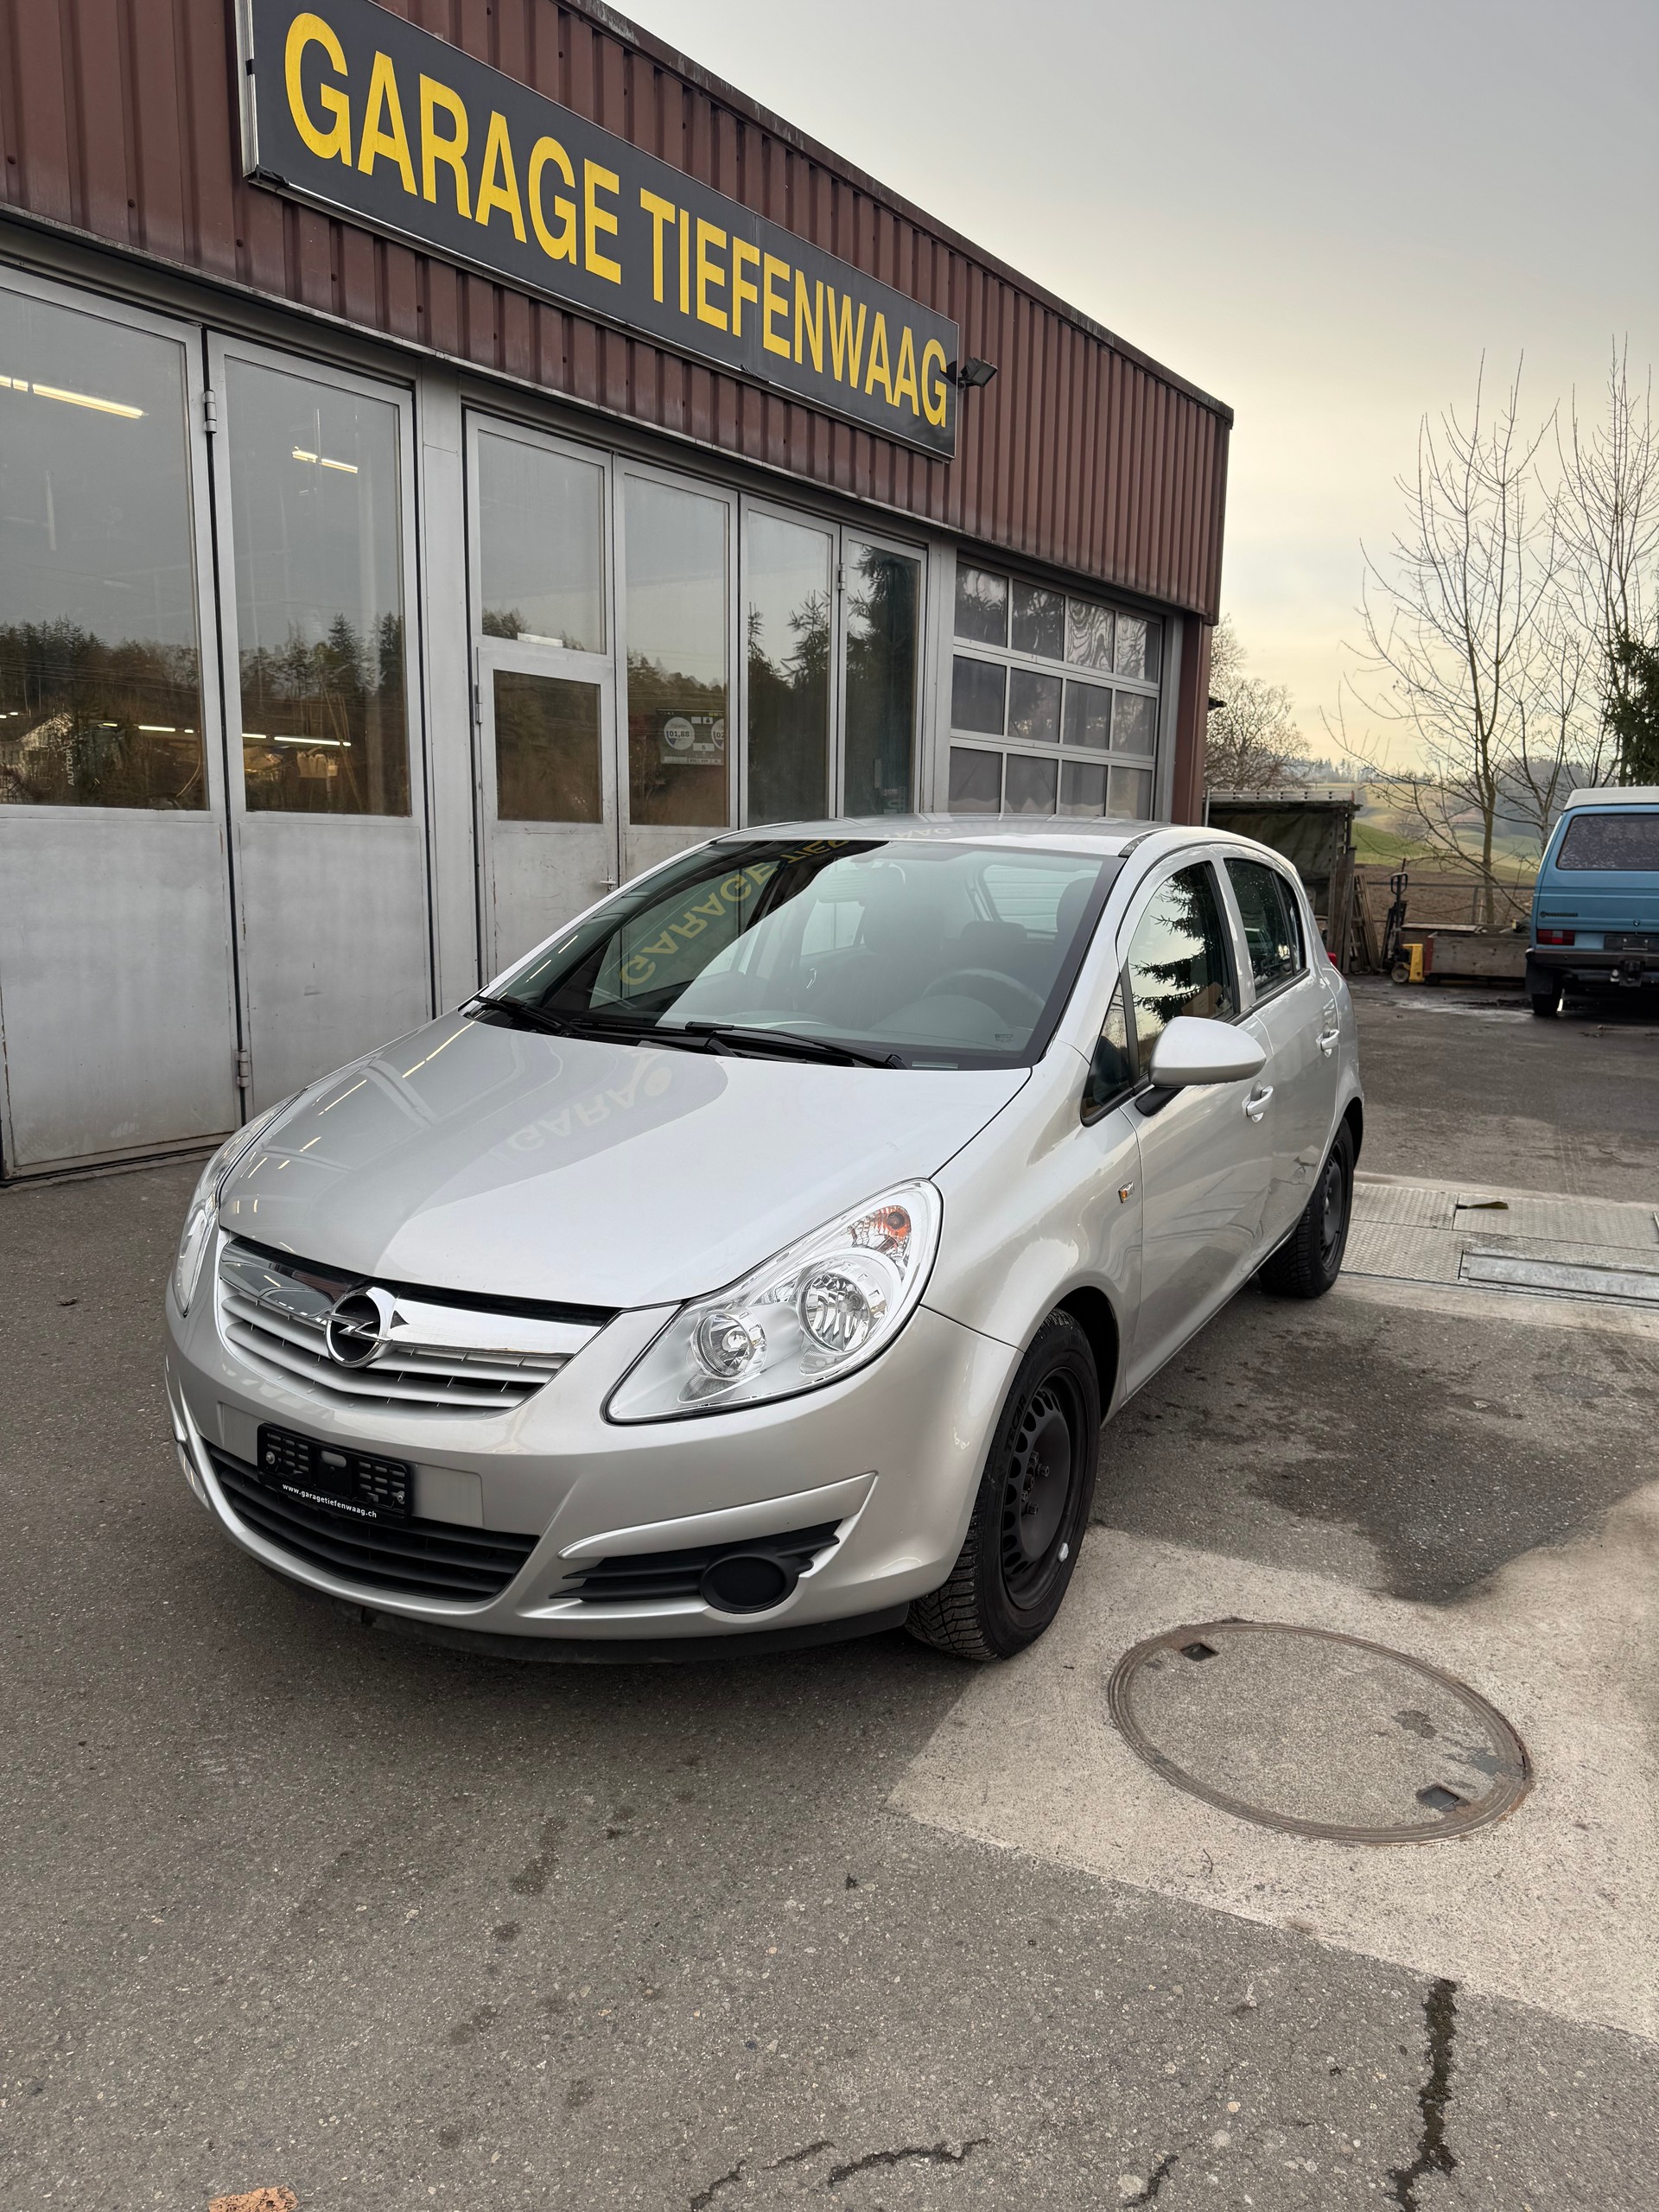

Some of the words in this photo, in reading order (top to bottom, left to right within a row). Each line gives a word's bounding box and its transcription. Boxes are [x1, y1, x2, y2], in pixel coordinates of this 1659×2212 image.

[284, 12, 621, 284] GARAGE
[639, 188, 947, 429] TIEFENWAAG
[282, 1483, 378, 1518] www.garagetiefenwaag.ch
